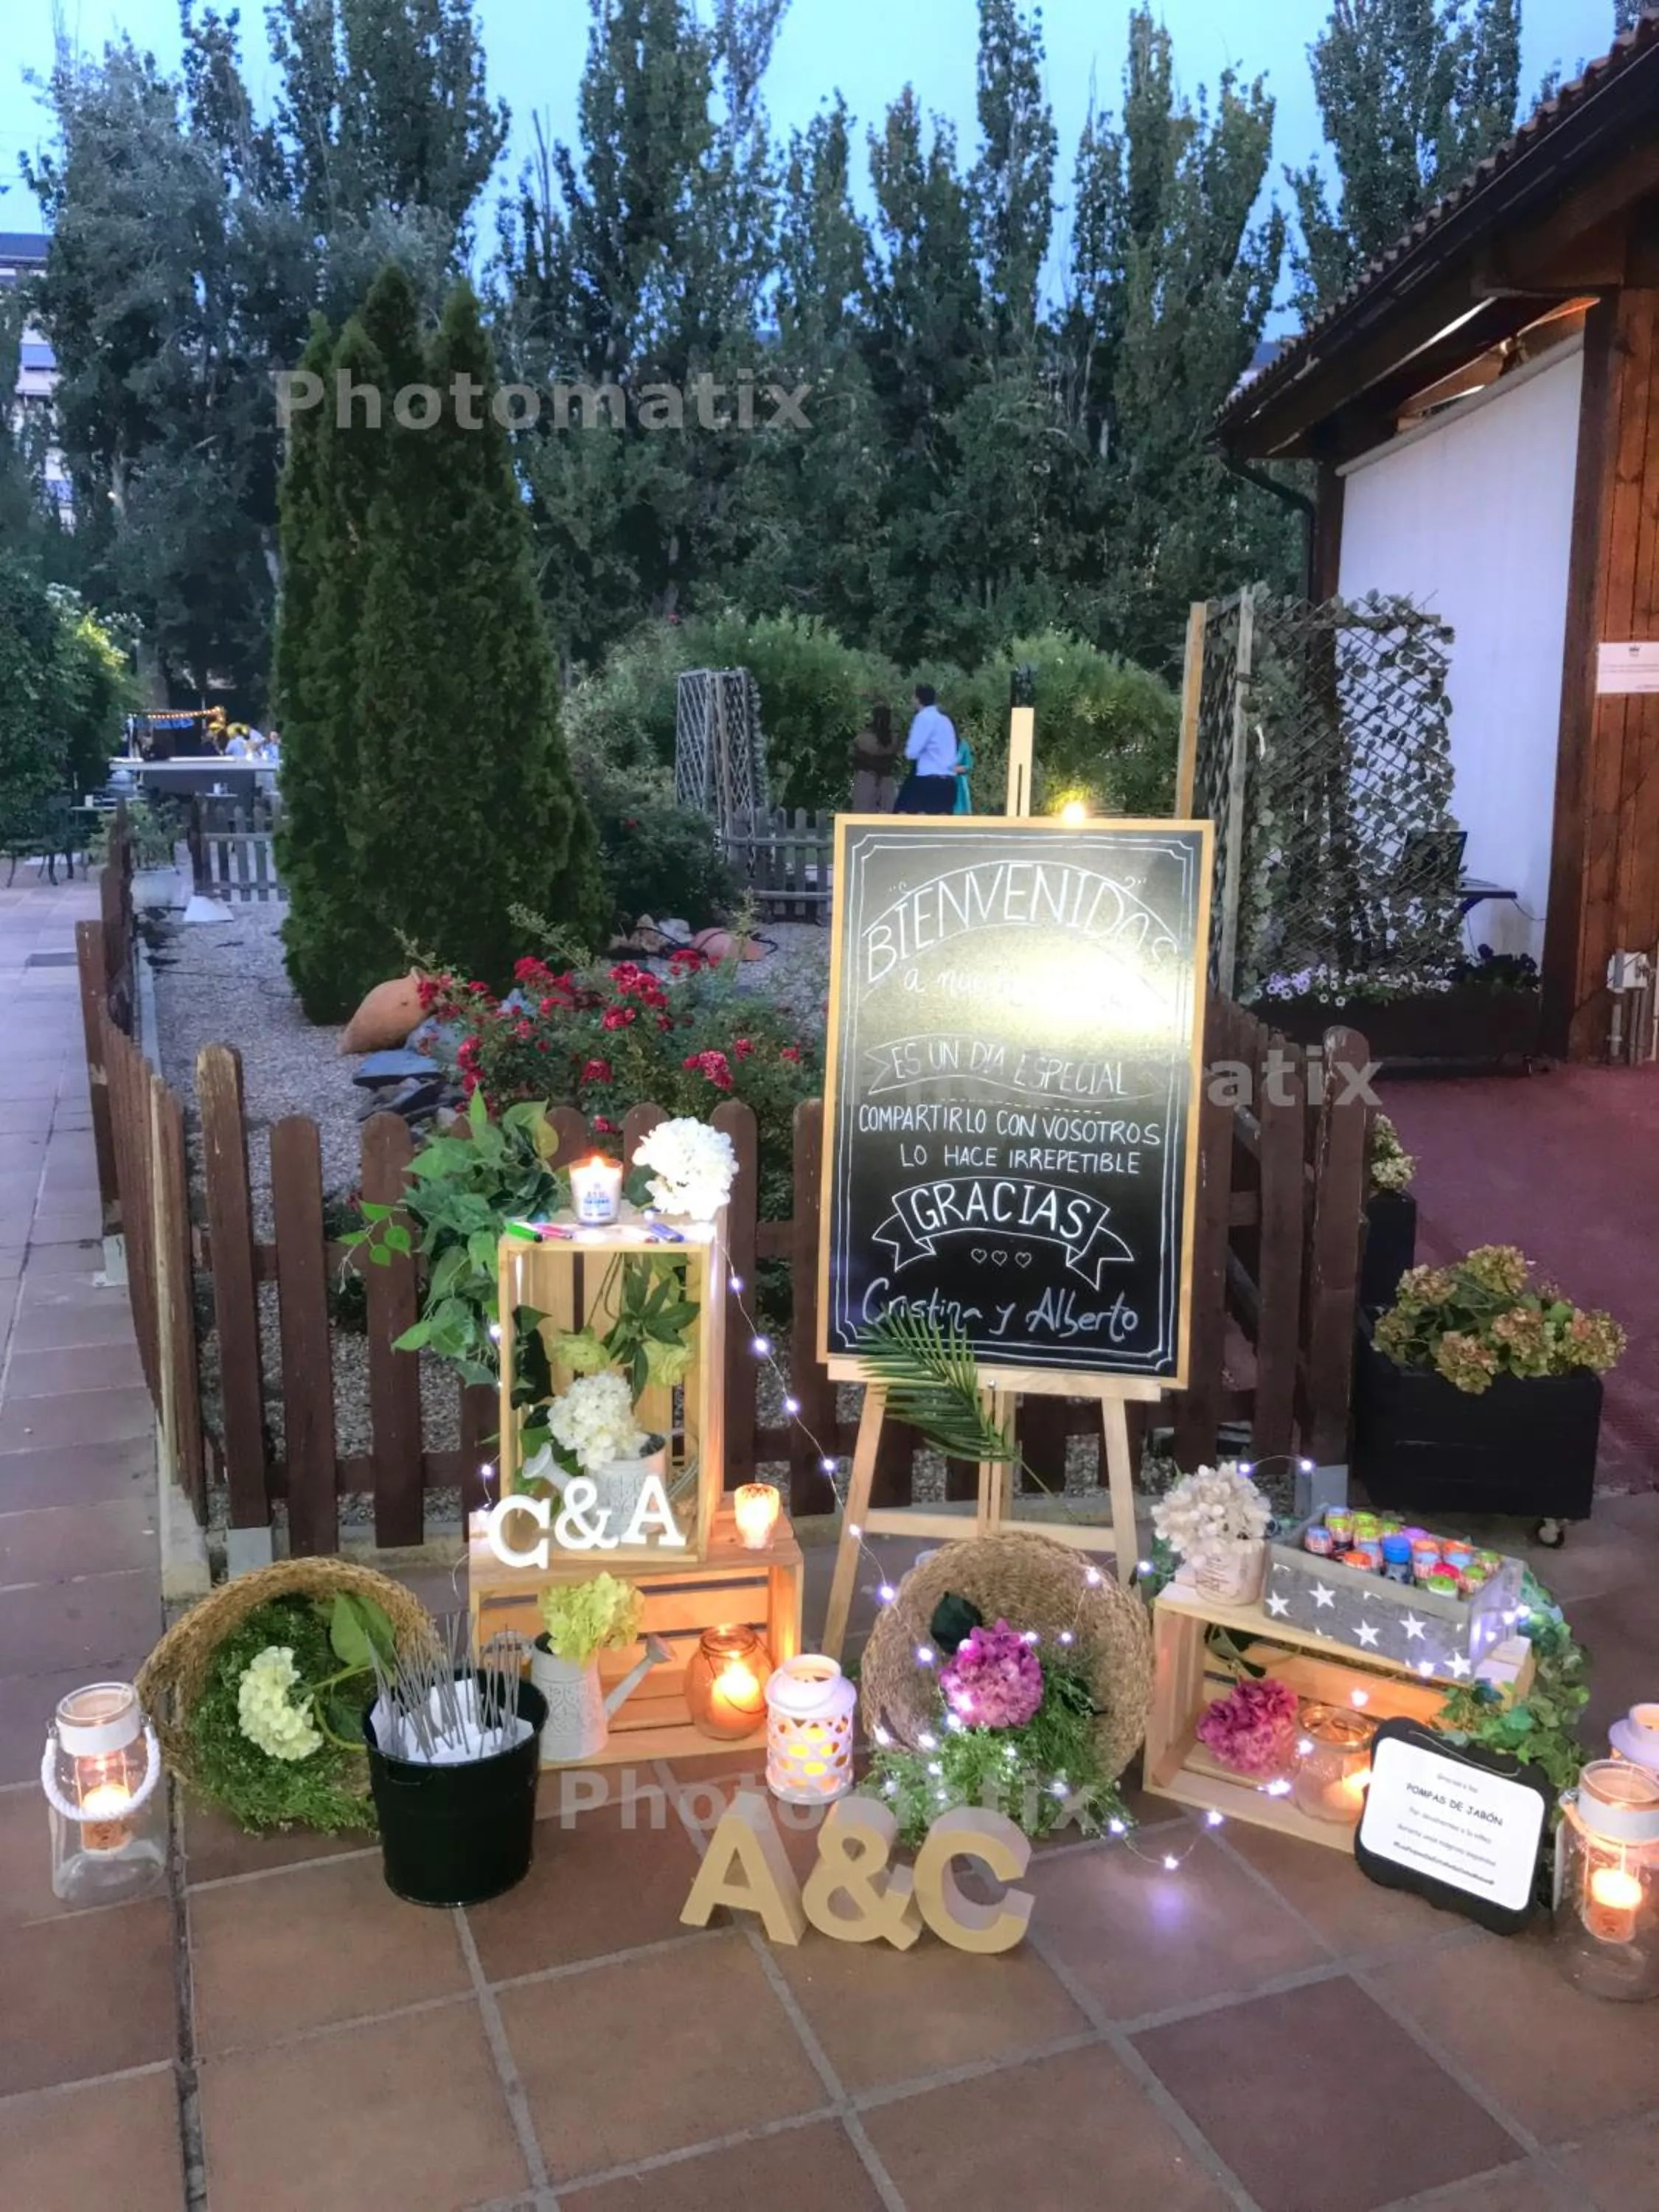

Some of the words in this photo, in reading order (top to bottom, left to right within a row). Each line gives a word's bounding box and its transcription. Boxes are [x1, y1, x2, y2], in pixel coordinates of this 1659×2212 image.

[891, 1043, 921, 1079] ES
[928, 1039, 959, 1071] UN
[1014, 1054, 1129, 1096] ESPECIAL
[859, 1104, 987, 1135] COMPARTIRLO
[996, 1109, 1034, 1138] CON
[1043, 1117, 1161, 1147] VOSOTROS
[900, 1144, 928, 1167] LO
[944, 1144, 998, 1168] HACE
[1009, 1148, 1141, 1175] IRREPETIBLE
[910, 1180, 1091, 1239] GRACIAS
[1026, 1287, 1138, 1342] Alberto
[487, 1475, 687, 1569] C&A
[1406, 1782, 1446, 1804] POMPAS
[1449, 1799, 1464, 1812] DE
[680, 1792, 1036, 1954] A&C
